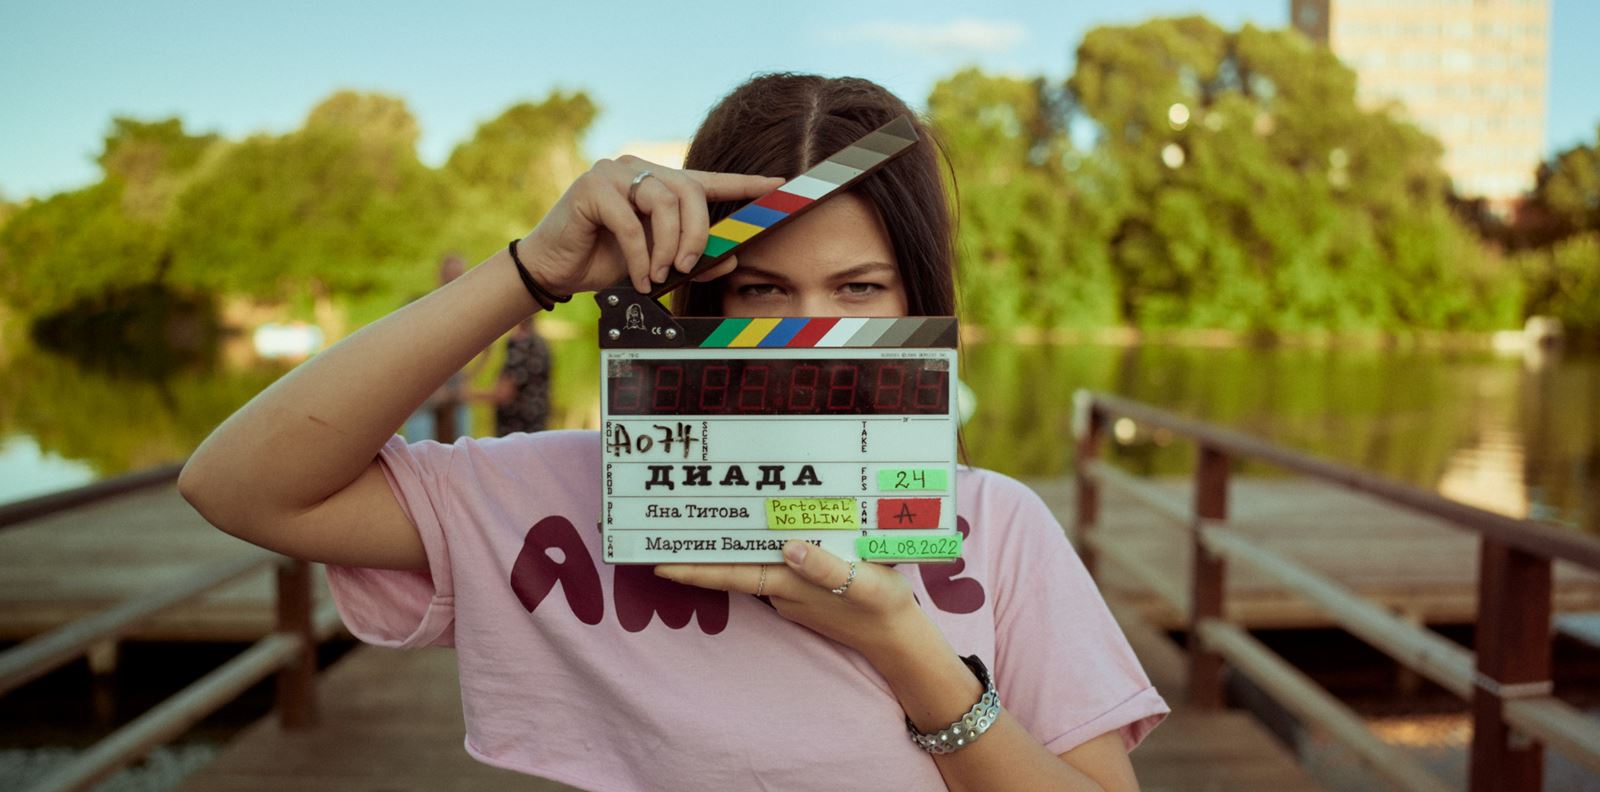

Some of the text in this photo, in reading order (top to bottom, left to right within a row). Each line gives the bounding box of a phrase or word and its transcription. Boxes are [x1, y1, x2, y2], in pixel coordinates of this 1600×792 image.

[645, 465, 822, 490] ДИАДА
[895, 470, 925, 488] 24
[645, 504, 750, 518] Яна Титова
[802, 512, 854, 525] BLINK
[893, 503, 916, 524] A
[645, 536, 822, 553] Мартин Балкани
[868, 538, 958, 555] 01.08.2022
